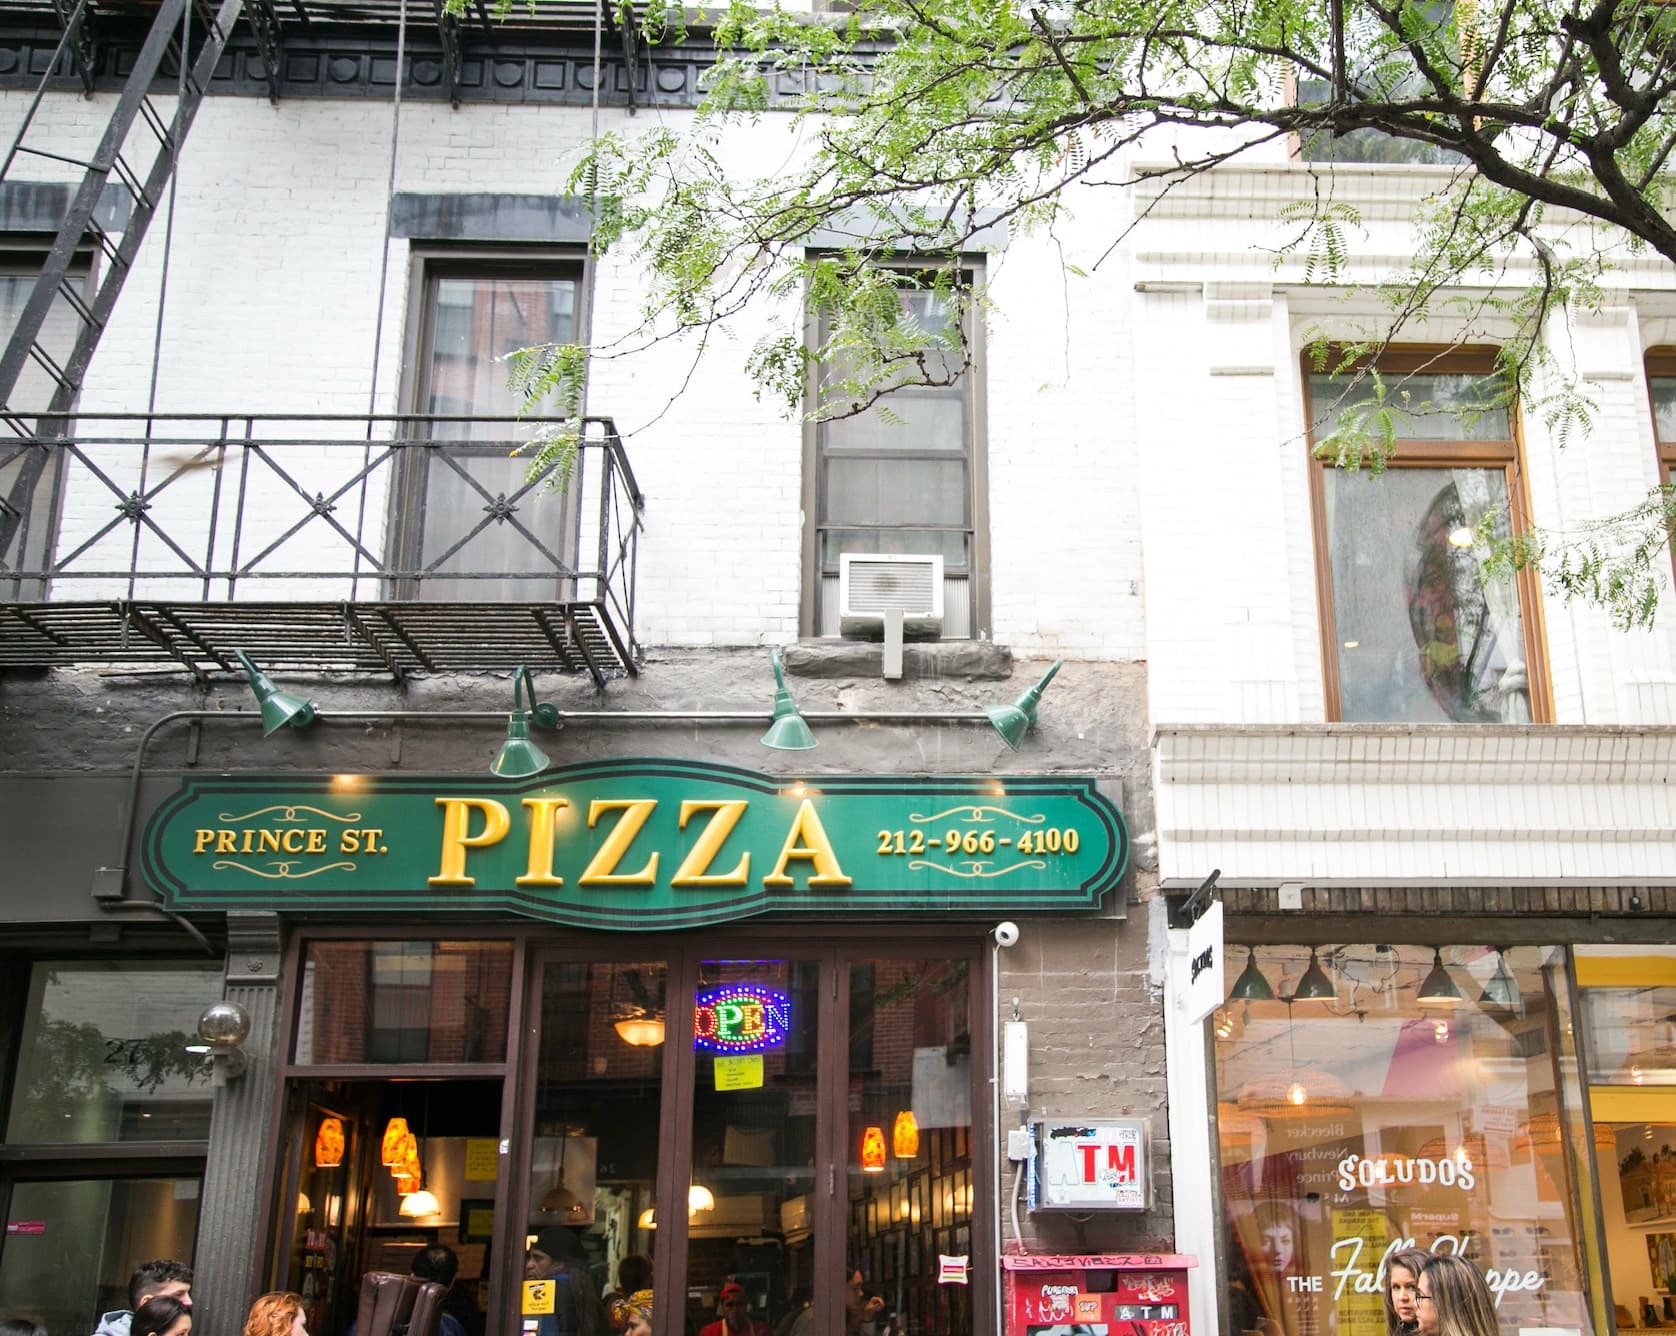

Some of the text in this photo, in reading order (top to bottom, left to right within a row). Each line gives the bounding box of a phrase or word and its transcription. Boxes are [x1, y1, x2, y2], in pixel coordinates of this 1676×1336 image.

[193, 828, 389, 854] PRINCE ST.
[427, 796, 853, 887] PIZZA
[877, 828, 1080, 855] 212-966-4100
[695, 1004, 791, 1036] OPEN
[1338, 1154, 1475, 1191] SOLUDOS
[1287, 1276, 1323, 1292] THE
